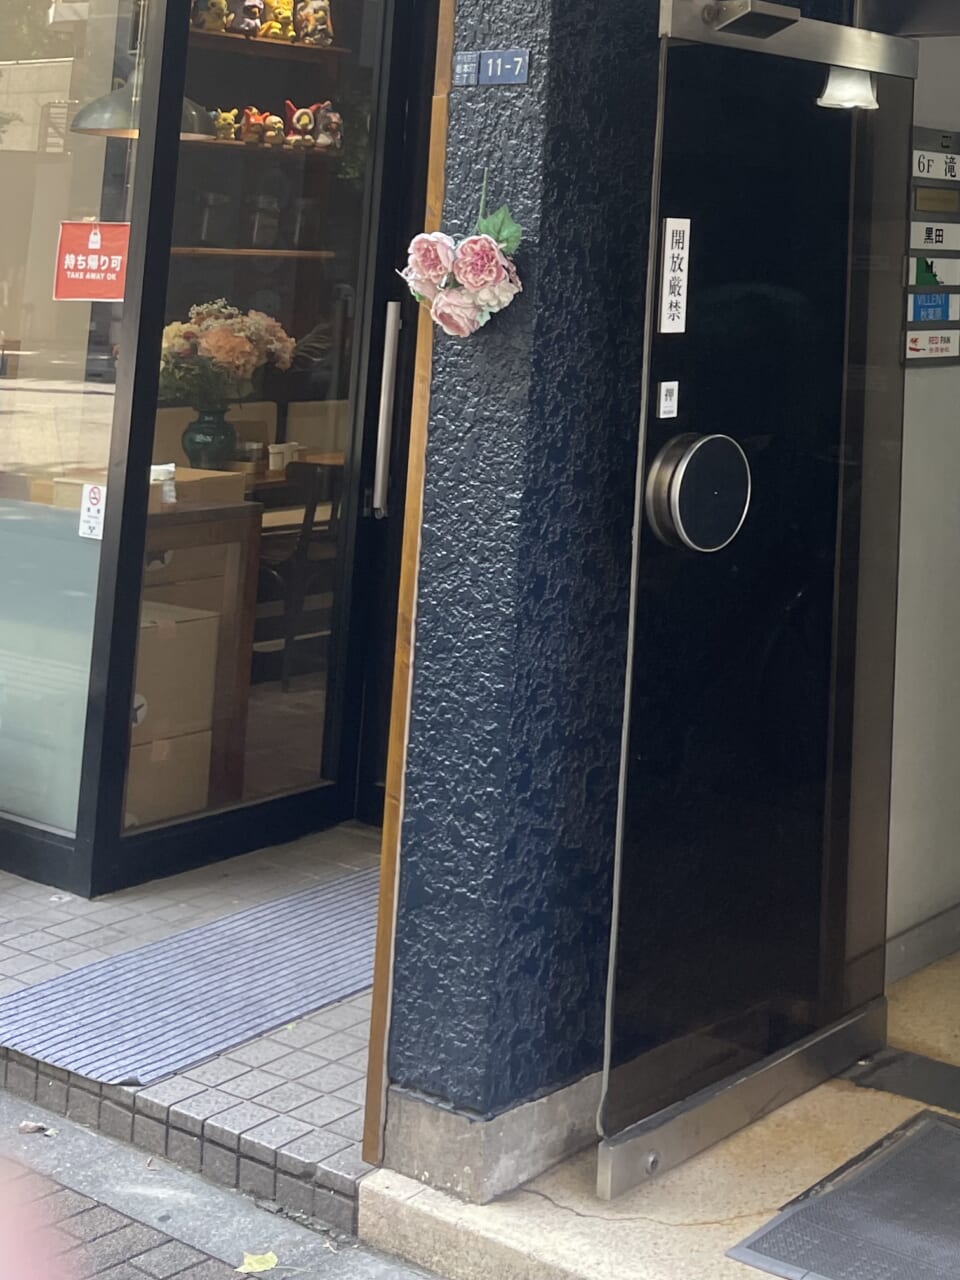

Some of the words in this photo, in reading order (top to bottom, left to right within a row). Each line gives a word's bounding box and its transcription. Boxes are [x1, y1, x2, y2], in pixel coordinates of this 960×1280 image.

[488, 58, 523, 76] 11-7
[918, 154, 934, 174] 6F
[923, 226, 945, 245] 黒田
[64, 254, 122, 271] 持ち帰り可
[85, 272, 105, 280] AWAY
[668, 230, 685, 321] 開放厳禁
